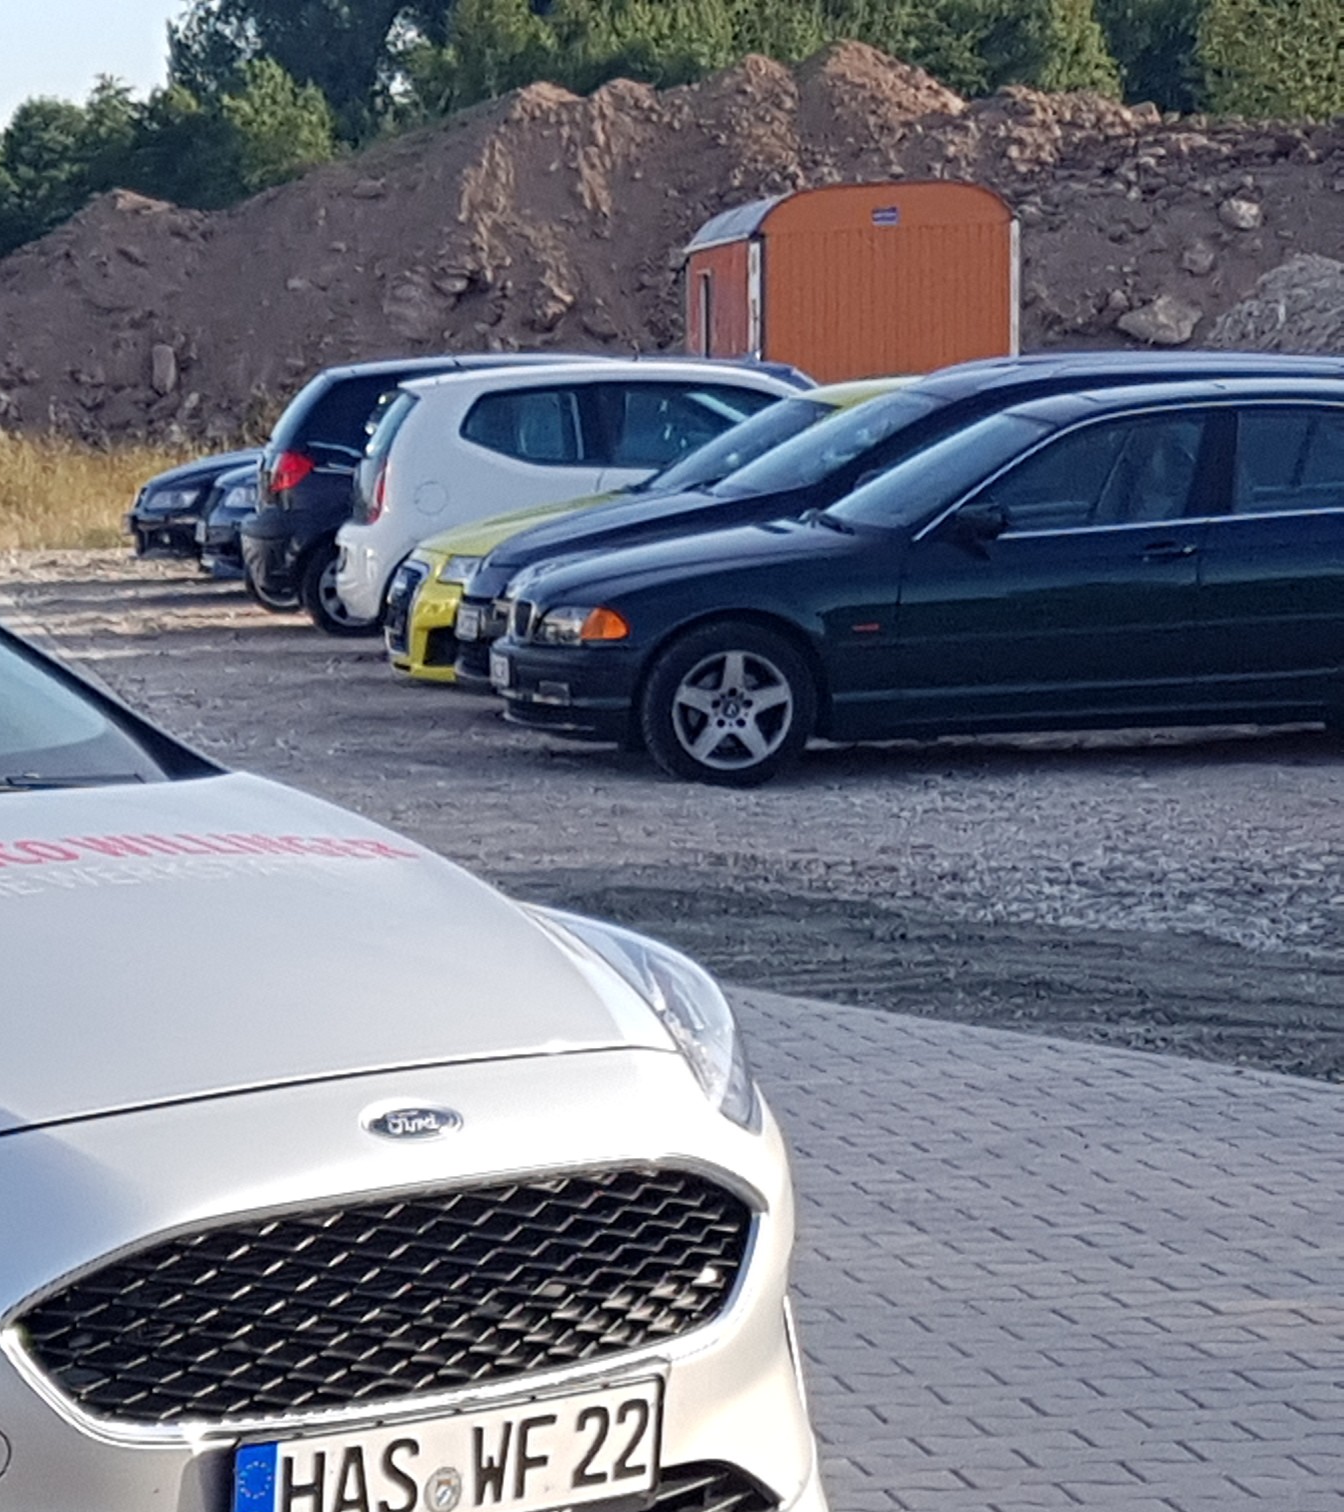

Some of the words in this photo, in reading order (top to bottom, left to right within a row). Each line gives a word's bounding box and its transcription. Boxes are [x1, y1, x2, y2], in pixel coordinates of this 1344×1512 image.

[60, 832, 420, 860] WILLINGER
[471, 1413, 558, 1508] WF
[571, 1398, 651, 1490] 22
